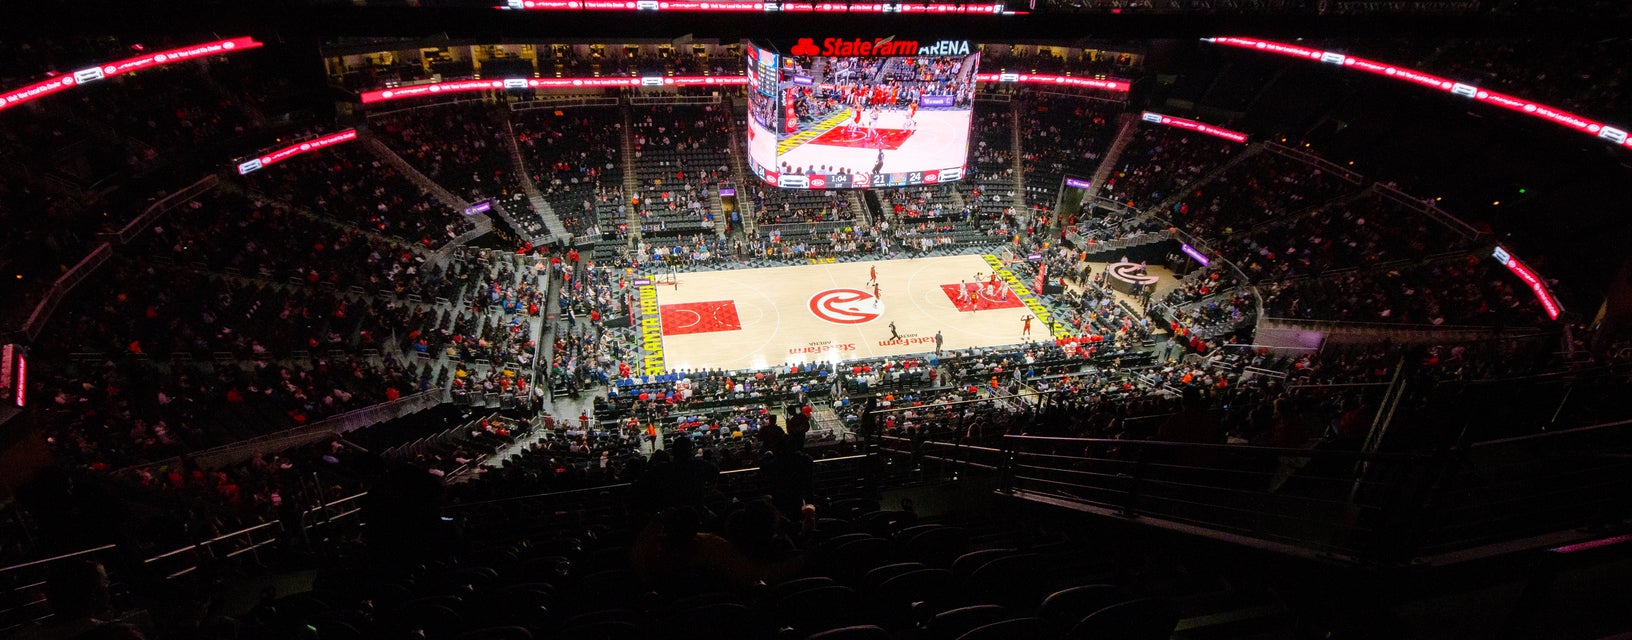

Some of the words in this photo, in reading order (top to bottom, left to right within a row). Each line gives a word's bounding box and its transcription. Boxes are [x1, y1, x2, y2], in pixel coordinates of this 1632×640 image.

[918, 40, 970, 55] ARENA
[28, 87, 40, 96] Local
[47, 82, 61, 90] Dealer
[831, 175, 847, 183] 1:04
[873, 175, 885, 184] 21
[909, 173, 921, 182] 24
[641, 317, 665, 376] ATLANTA
